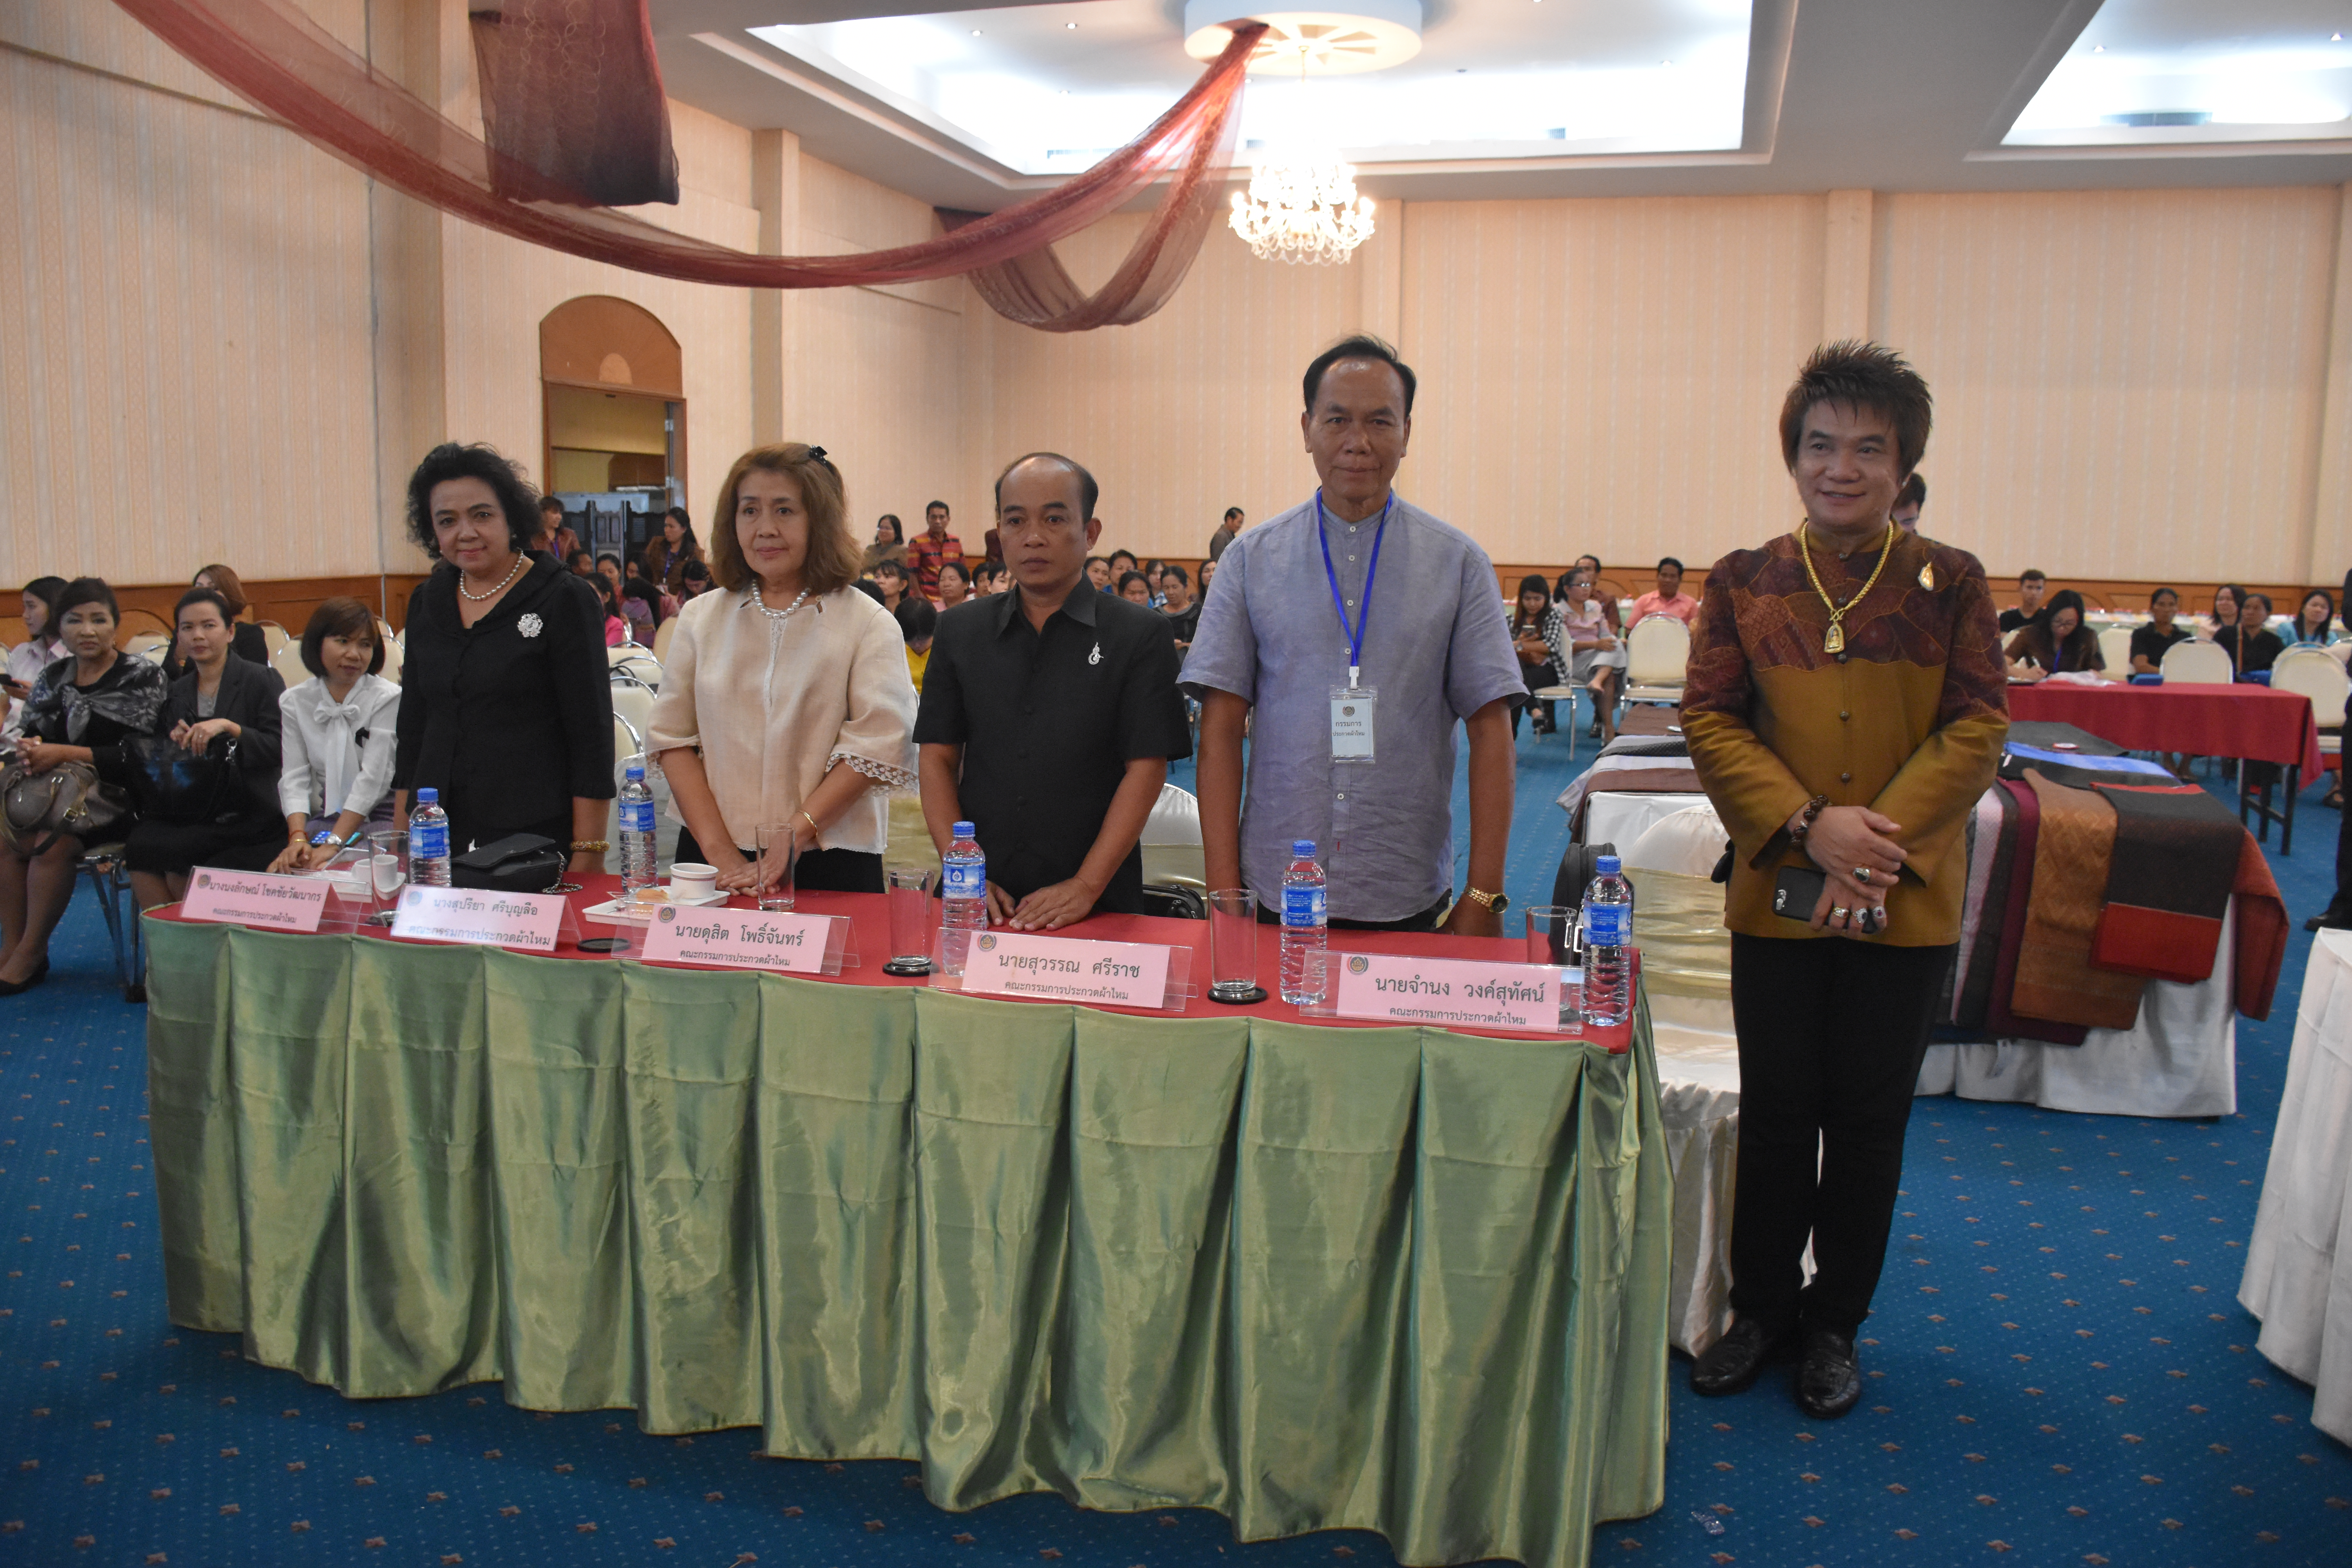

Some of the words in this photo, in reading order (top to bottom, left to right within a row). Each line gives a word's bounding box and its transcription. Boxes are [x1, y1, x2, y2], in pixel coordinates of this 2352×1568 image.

[408, 925, 550, 946] คณะกรรมการประกวดผ้าไหม
[676, 923, 729, 944] นายดุสิต
[741, 922, 805, 946] โพธิ์จันทร์
[680, 950, 790, 966] คณะกรรมการประกวดผ้าไหม
[999, 955, 1080, 975] นายสุวรรณ
[1093, 957, 1140, 978] ศรีราช
[1005, 981, 1129, 1000] คณะกรรมการประกวดผ้าไหม
[1376, 974, 1450, 995] นายจำนง
[1464, 979, 1545, 1006] วงค์สุทัศน์
[1390, 1007, 1526, 1025] คณะกรรมการประกวดผ้าไหม
